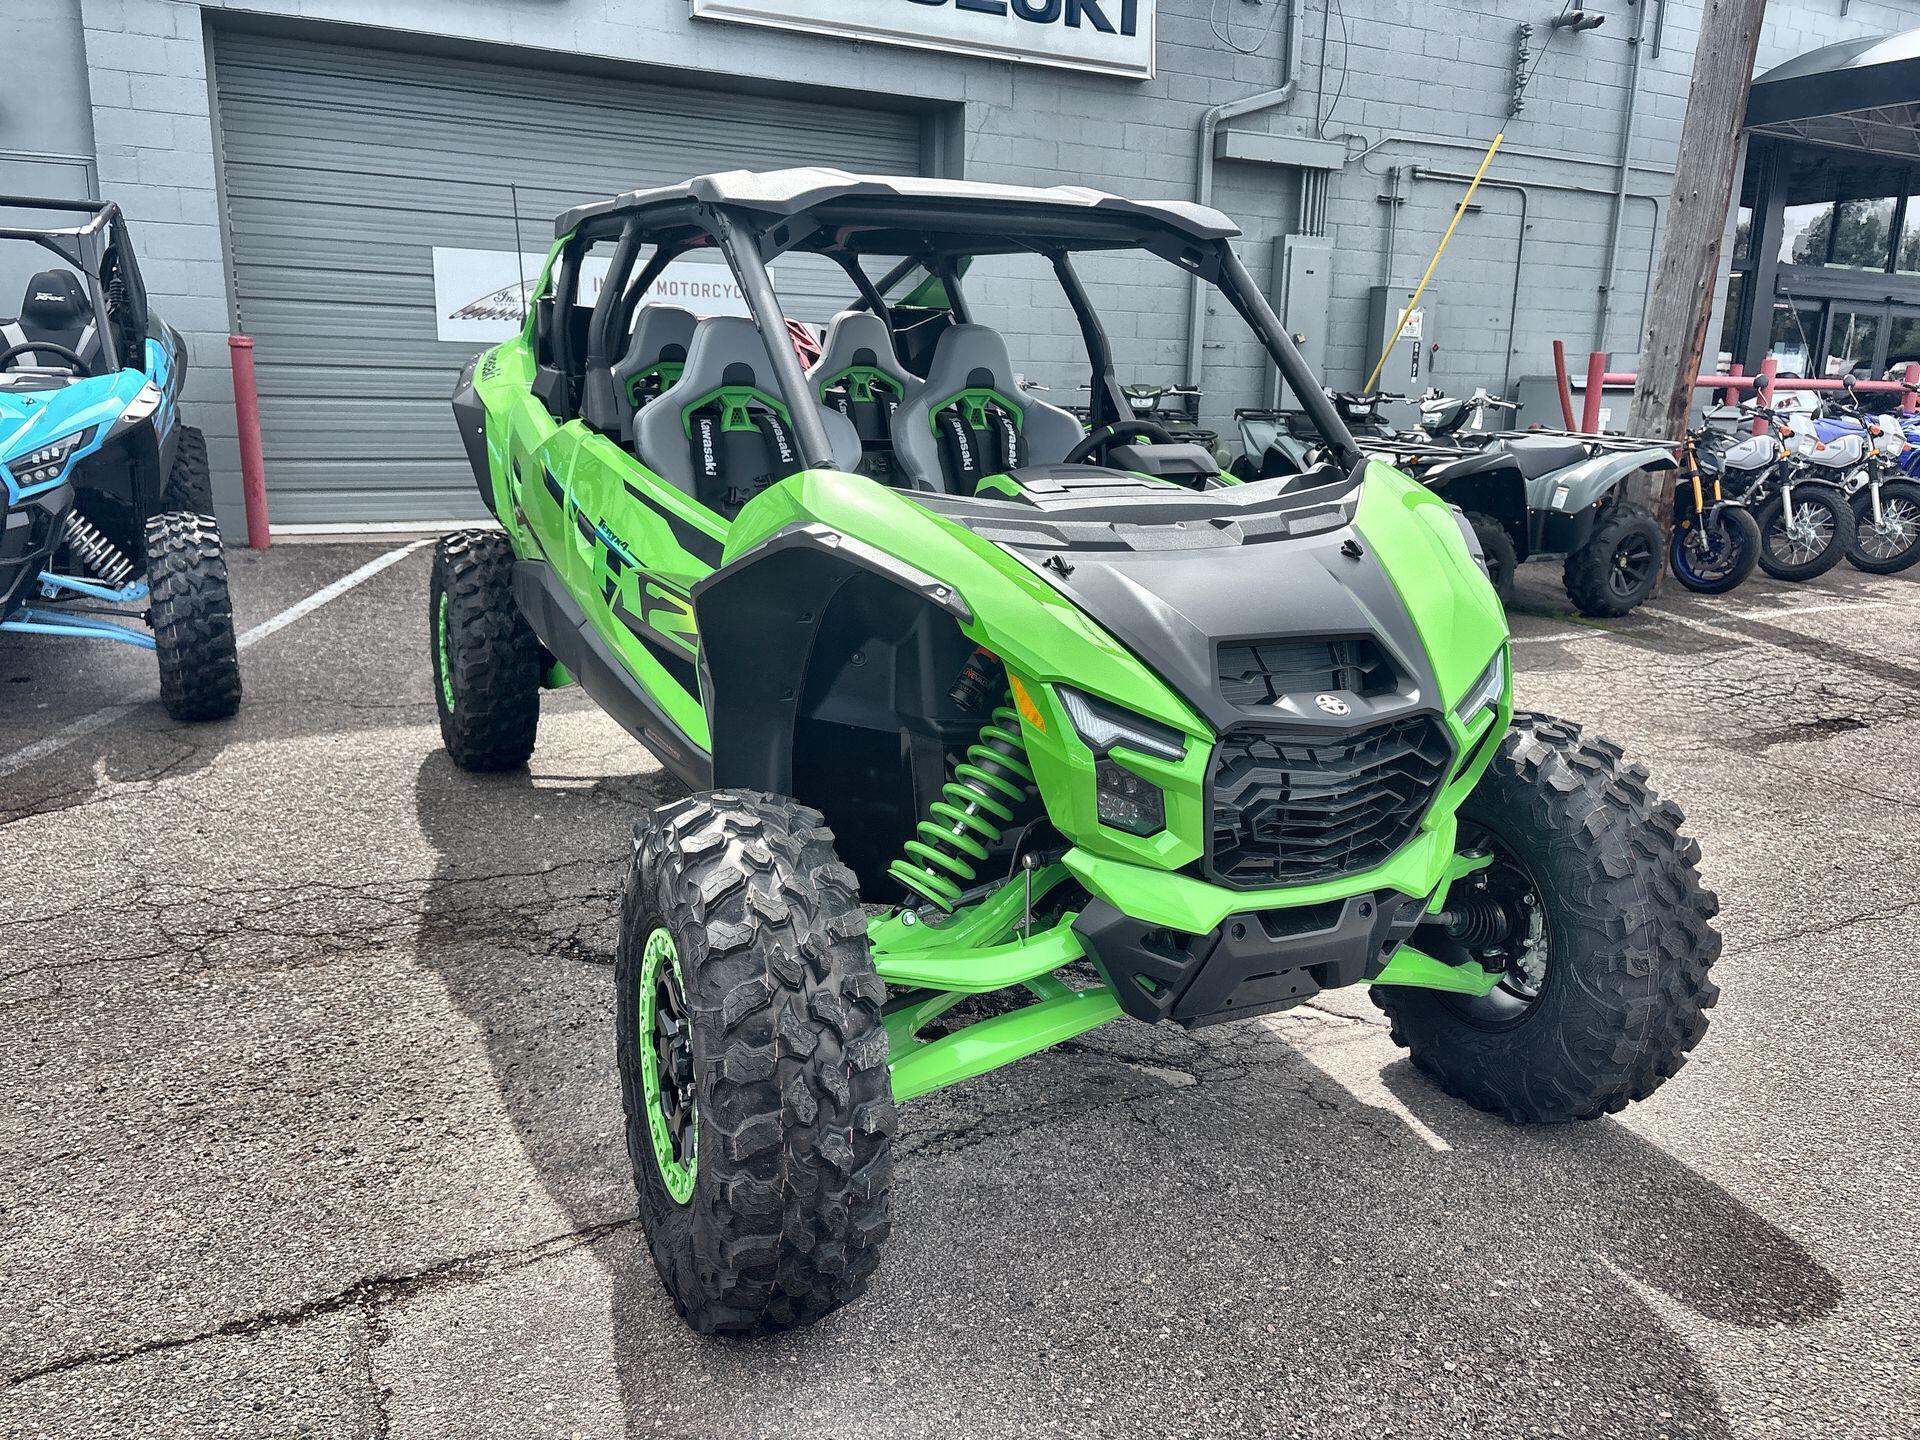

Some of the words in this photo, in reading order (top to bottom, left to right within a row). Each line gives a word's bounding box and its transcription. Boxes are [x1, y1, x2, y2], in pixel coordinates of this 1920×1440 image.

[657, 281, 742, 300] MOTORCYC
[700, 418, 717, 477] Kawasaki
[949, 417, 974, 471] Kawasaki
